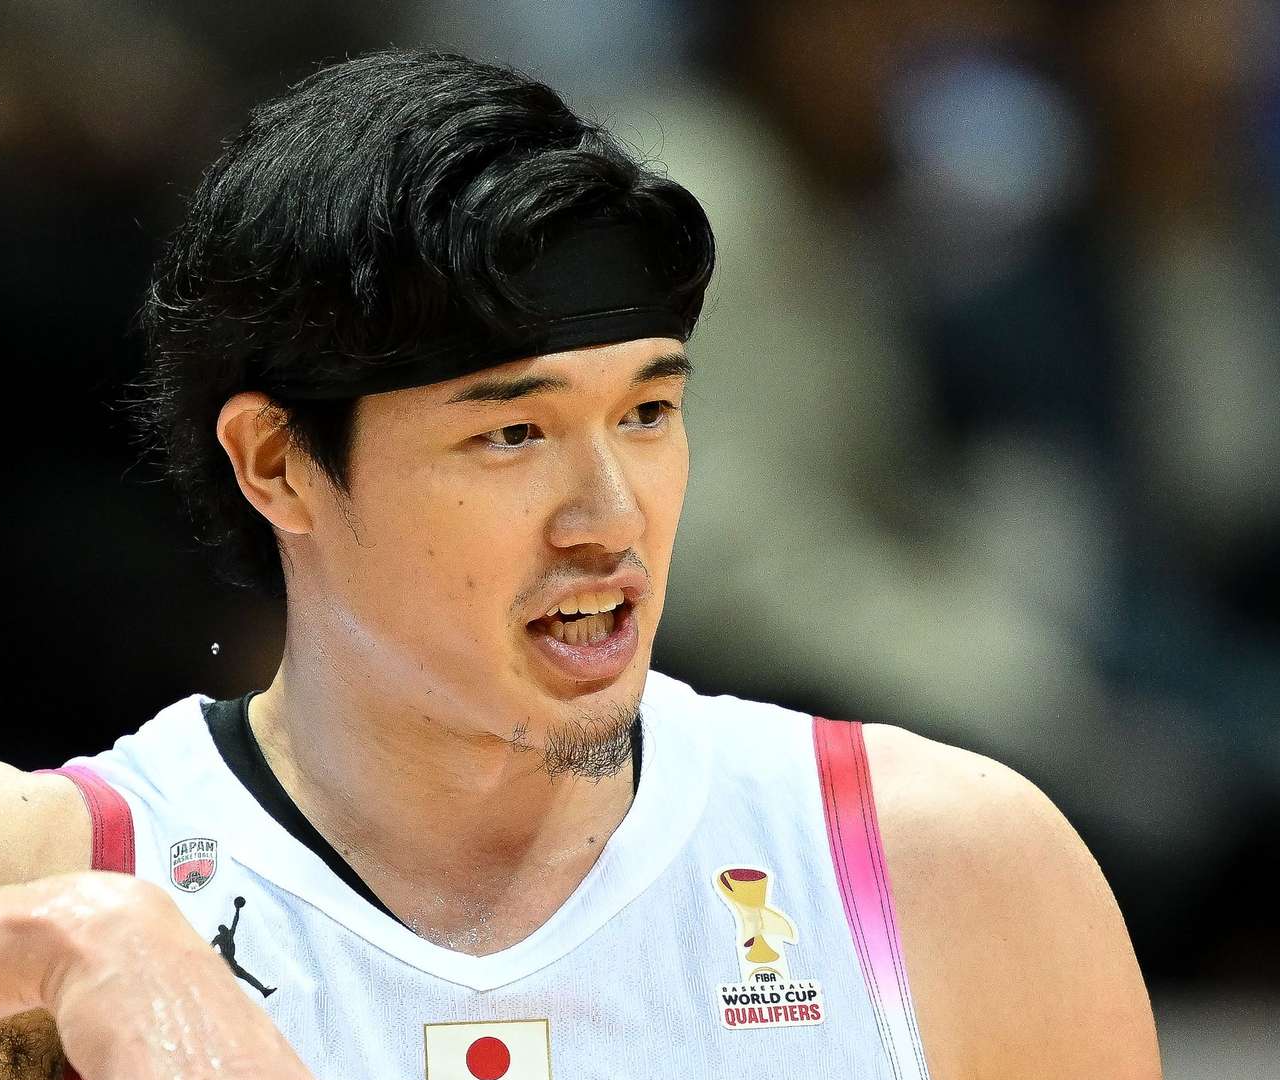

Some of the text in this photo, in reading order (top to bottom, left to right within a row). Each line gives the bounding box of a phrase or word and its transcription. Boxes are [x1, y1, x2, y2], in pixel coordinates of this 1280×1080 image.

[173, 841, 214, 859] JAPAN
[755, 973, 776, 983] FIBA
[722, 982, 814, 993] BASKETBALL
[722, 990, 817, 1006] WORLD CUP
[724, 1004, 821, 1026] QUALIFIERS
